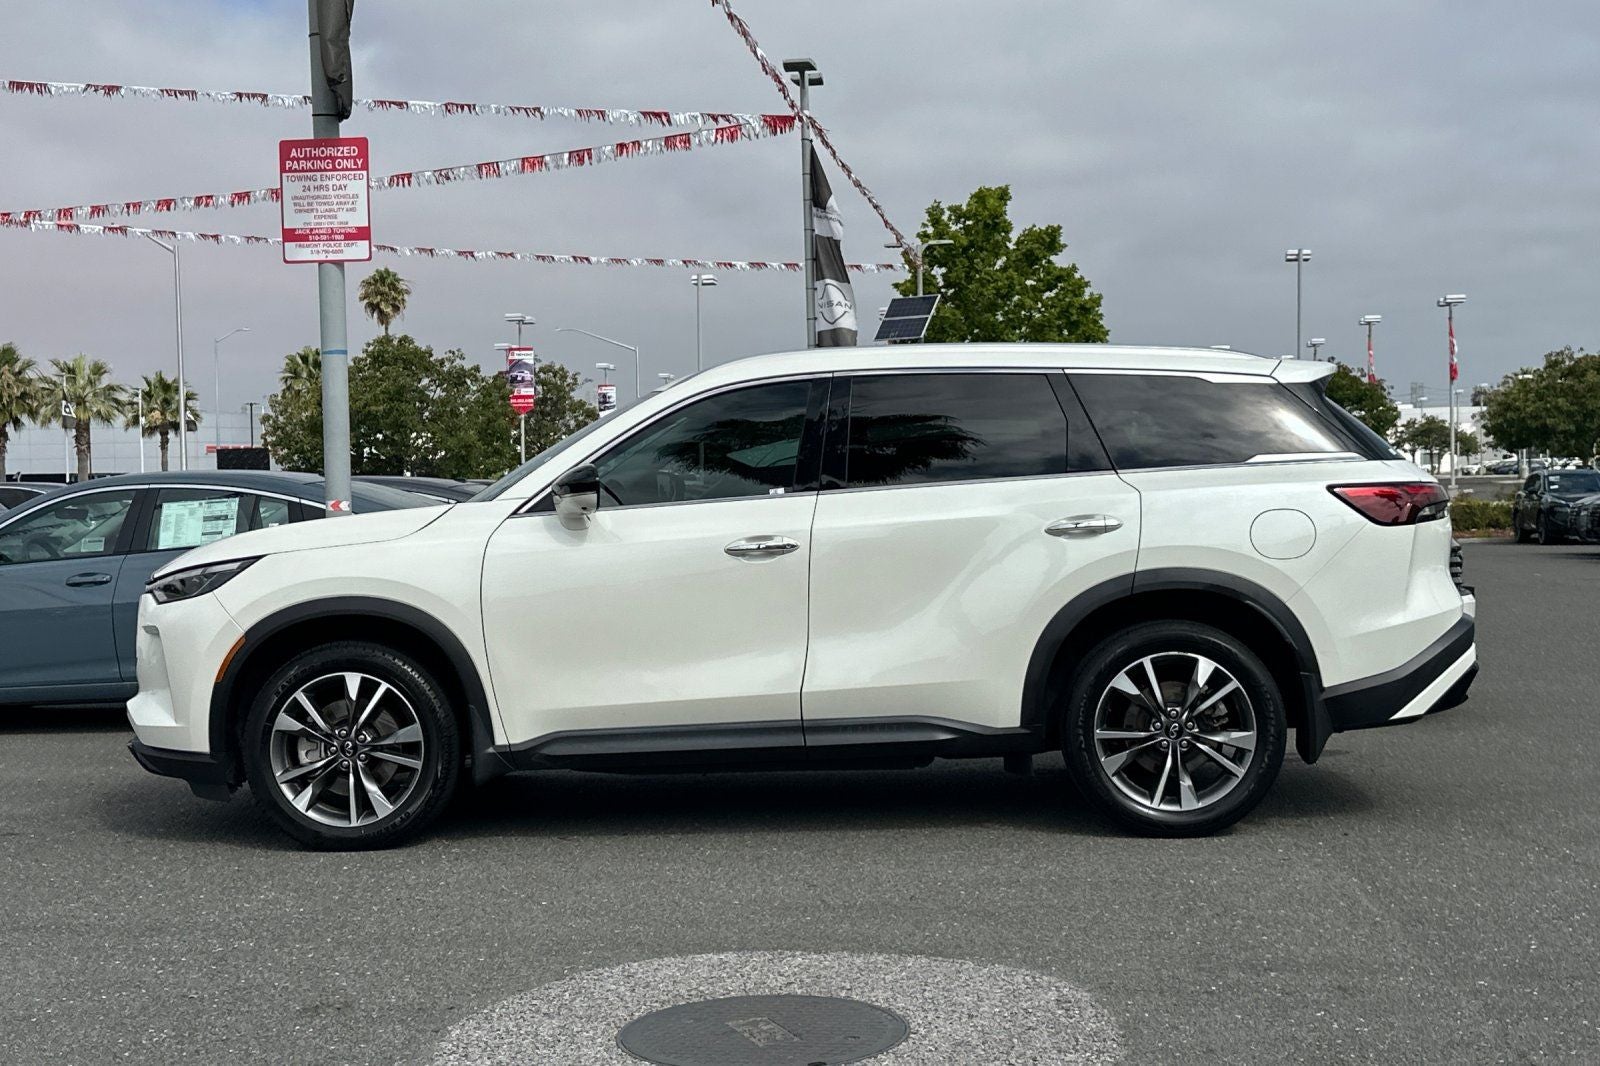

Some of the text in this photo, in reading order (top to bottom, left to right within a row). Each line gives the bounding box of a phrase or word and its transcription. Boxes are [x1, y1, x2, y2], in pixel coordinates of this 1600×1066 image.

[290, 146, 358, 158] AUTHORIZED
[286, 159, 363, 170] PARKING ONLY
[286, 173, 364, 183] TOWING ENFORCED
[313, 184, 330, 192] HRS
